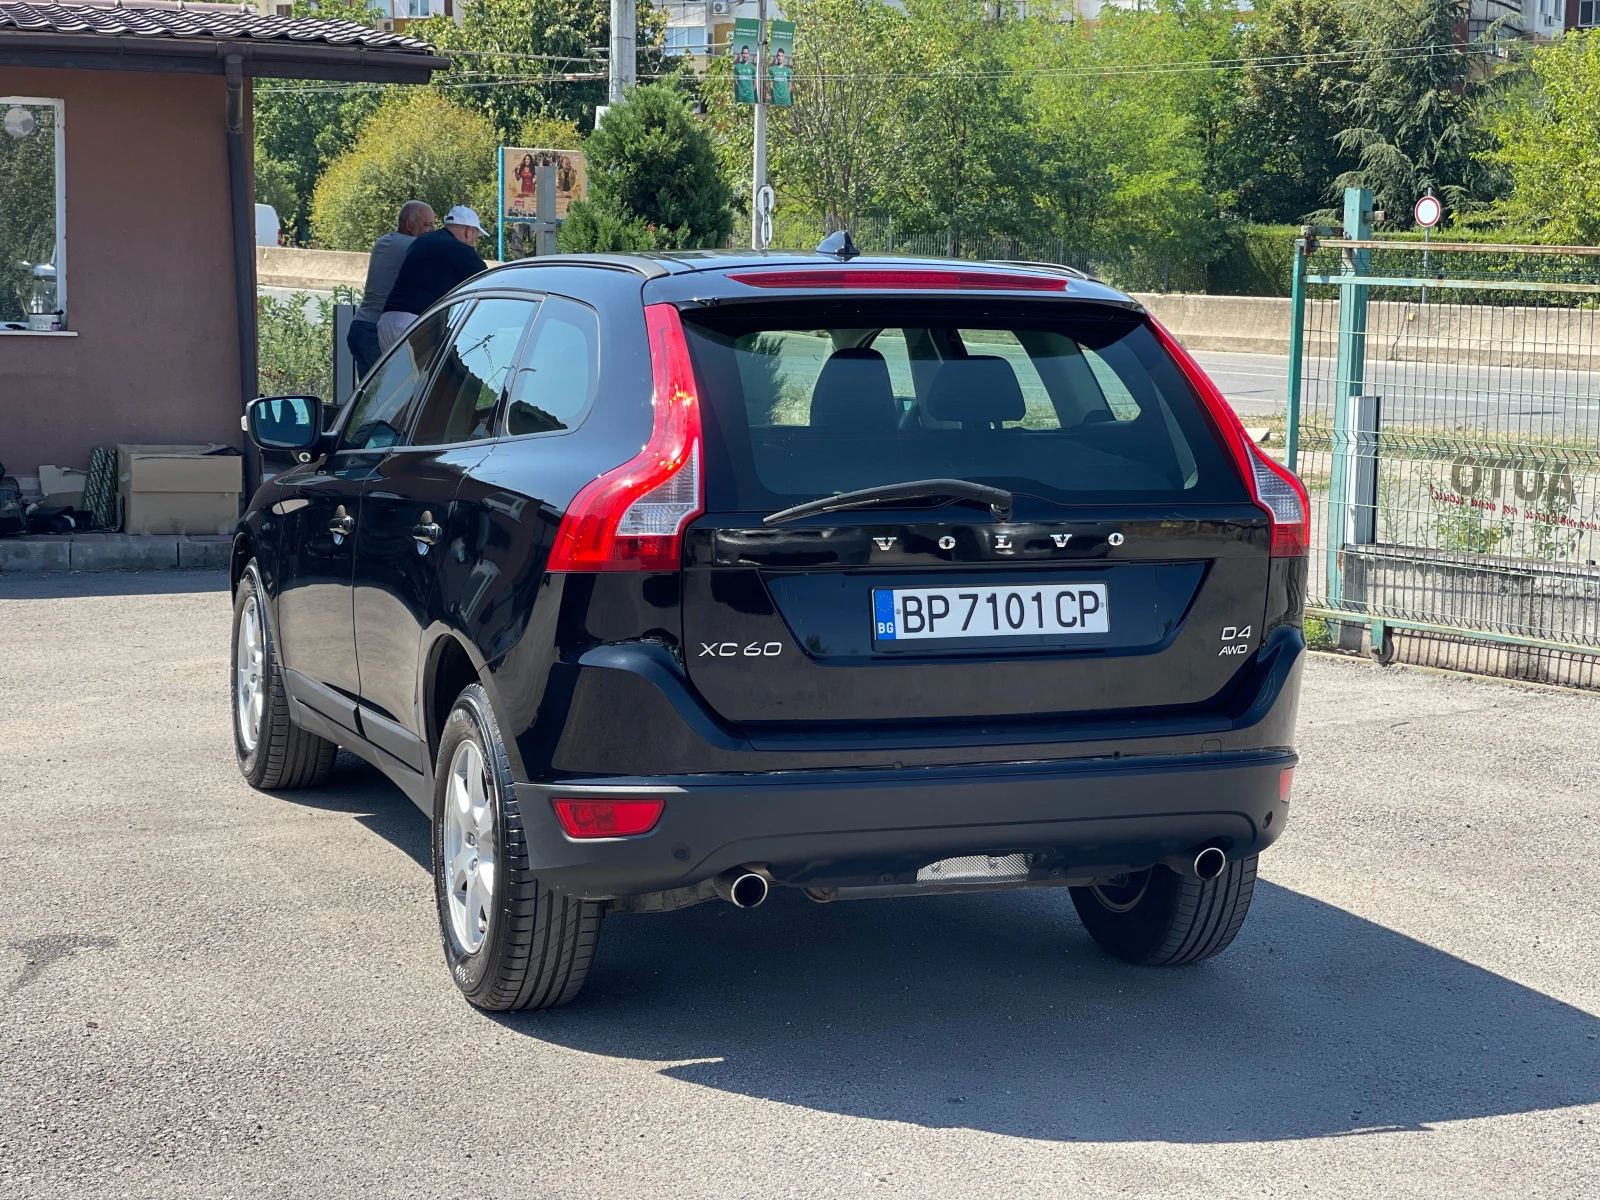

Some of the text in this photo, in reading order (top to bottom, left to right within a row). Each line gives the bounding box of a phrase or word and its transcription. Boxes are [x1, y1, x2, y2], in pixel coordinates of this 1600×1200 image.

[873, 532, 1124, 551] VOLVO
[878, 622, 894, 634] BG
[1221, 625, 1251, 640] D4
[1218, 644, 1247, 656] AWD
